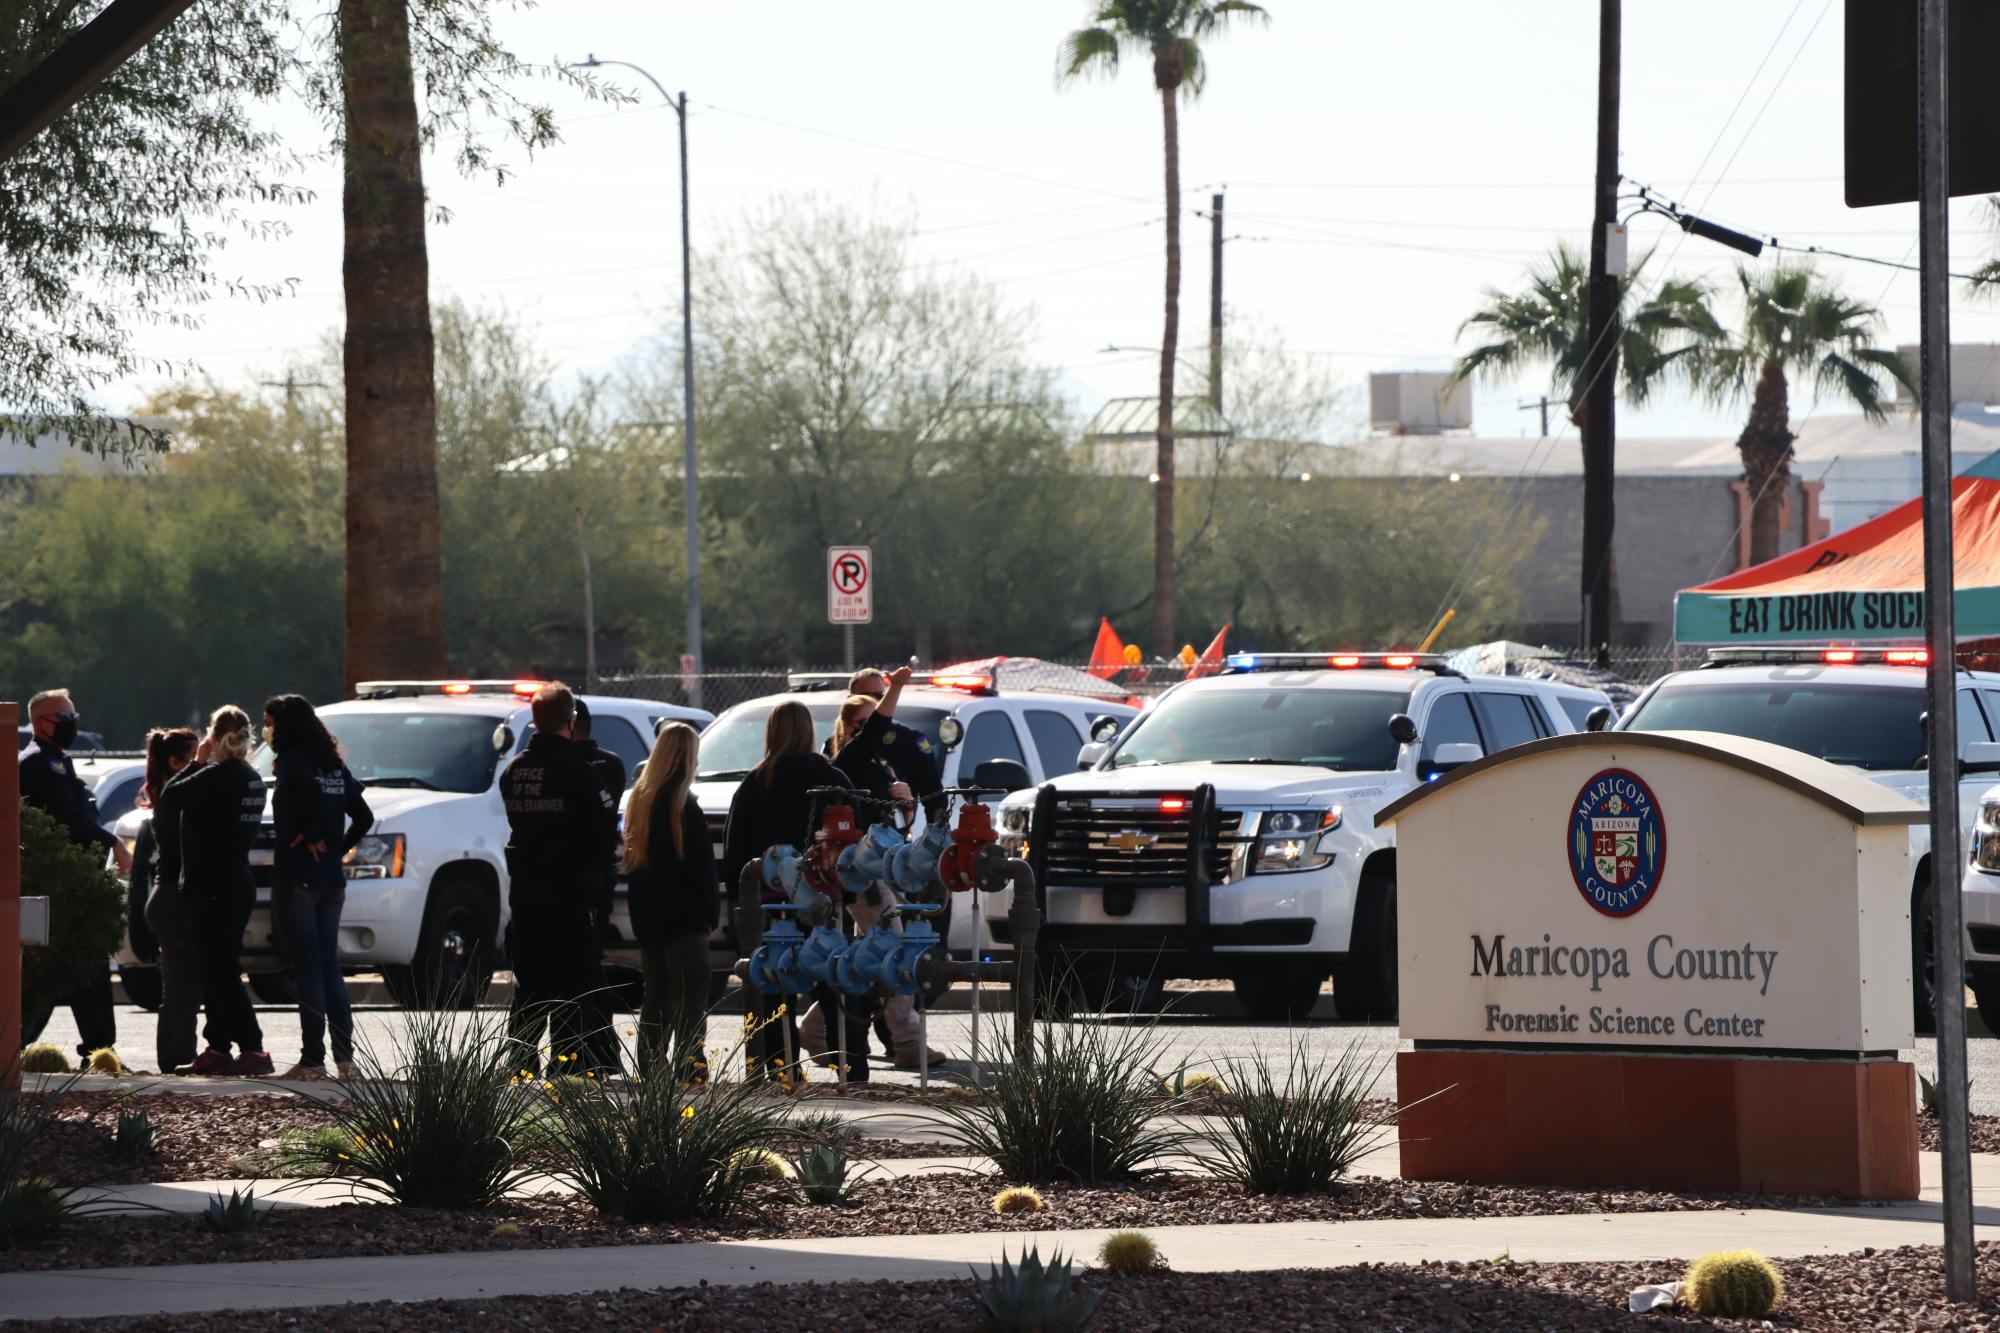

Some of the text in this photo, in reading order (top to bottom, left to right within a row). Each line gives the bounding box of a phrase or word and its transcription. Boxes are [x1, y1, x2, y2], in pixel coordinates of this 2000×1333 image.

[1730, 591, 1927, 634] EAT DRINK SOCI
[512, 768, 545, 780] OFFICE
[525, 783, 542, 796] THE
[1578, 778, 1651, 820] MARICOPA
[1594, 819, 1637, 829] ARIZONA
[1585, 874, 1648, 907] COUNTY
[1470, 933, 1778, 996] Maricopa County
[1485, 1004, 1766, 1037] Forensic Science Center
